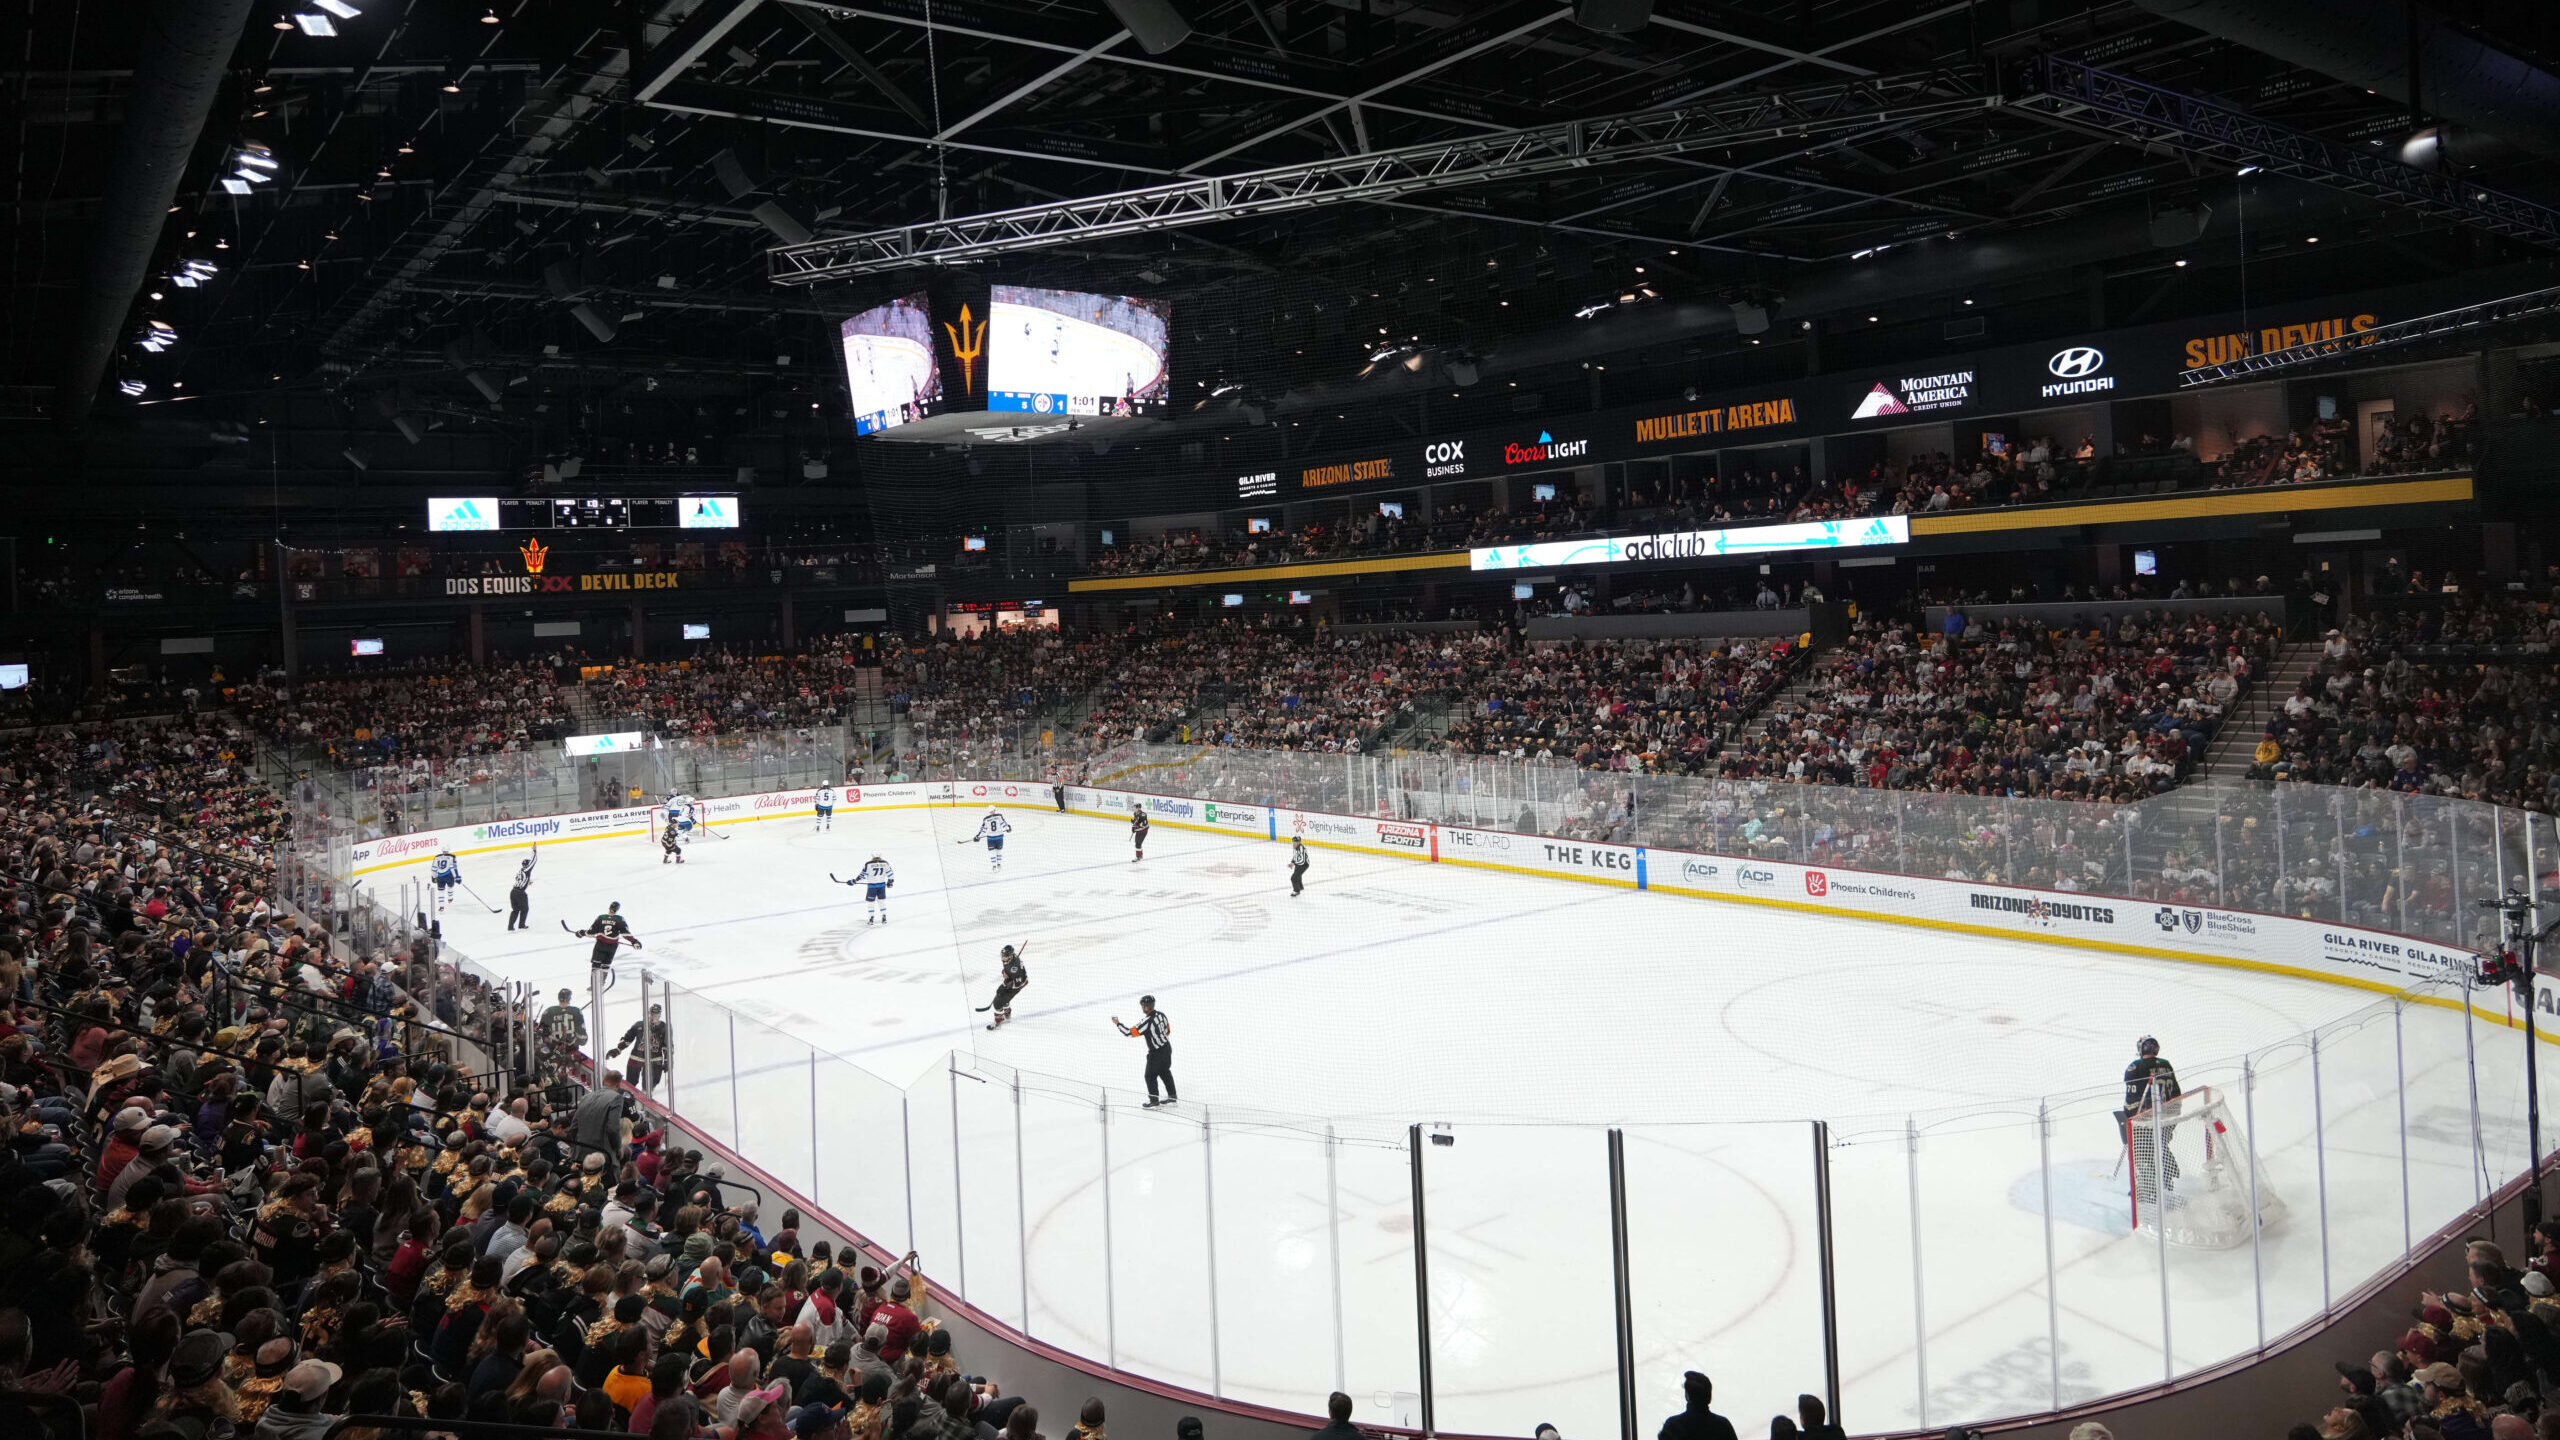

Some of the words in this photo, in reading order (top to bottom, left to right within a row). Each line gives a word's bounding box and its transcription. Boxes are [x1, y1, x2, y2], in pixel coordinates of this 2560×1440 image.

[2185, 332, 2249, 368] SUN
[2261, 314, 2376, 353] DEVILS
[1900, 371, 1973, 392] MOUNTAIN
[2042, 377, 2114, 397] HYUNDAI
[1073, 396, 1095, 406] 1:01
[1907, 386, 1968, 405] AMERICA
[1057, 401, 1064, 410] 1
[1103, 402, 1110, 412] 2
[1913, 403, 1938, 411] CREDIT
[1940, 400, 1962, 408] UNION
[1636, 408, 1723, 443] MULLETT
[1727, 399, 1795, 430] ARENA
[1425, 440, 1464, 464] COX
[1505, 442, 1546, 465] Coors
[1547, 440, 1588, 460] LIGHT
[1302, 463, 1350, 488] ARIZONA
[1353, 458, 1390, 482] STATE
[1427, 463, 1464, 477] BUSINESS
[1239, 475, 1254, 485] GILA
[1255, 472, 1276, 483] RIVER
[563, 507, 570, 515] 2
[439, 520, 490, 530] adidas
[688, 519, 731, 528] adidas
[1625, 531, 1705, 561] adiclub
[1860, 534, 1896, 546] adidas
[890, 572, 937, 580] Mortenson
[446, 577, 479, 595] DOS
[483, 576, 532, 595] EQUIS
[541, 576, 573, 592] XX
[581, 573, 630, 591] DEVIL
[633, 572, 678, 589] DECK
[118, 593, 144, 601] complete
[823, 792, 829, 801] 5
[888, 789, 916, 797] Children's
[713, 803, 741, 813] Health
[754, 793, 790, 810] Bally
[1153, 798, 1194, 818] MedSupply
[588, 814, 609, 822] RIVER
[1207, 808, 1255, 823] enterprise
[488, 819, 560, 839] MedSupply
[991, 820, 997, 831] 8
[1309, 820, 1333, 835] Dignity
[1334, 823, 1357, 834] Health
[1379, 825, 1422, 837] ARIZONA
[1383, 834, 1423, 847] SPORTS
[377, 839, 411, 857] Bally
[411, 838, 438, 850] SPORTS
[1544, 845, 1583, 865] THE
[1592, 850, 1631, 870] KEG
[437, 860, 447, 869] 19
[1688, 863, 1718, 876] ACP
[873, 868, 884, 876] 71
[1742, 869, 1774, 882] ACP
[1830, 881, 1867, 895] Phoenix
[1869, 886, 1916, 900] Children's
[1971, 893, 2034, 914] ARIZONA
[2041, 902, 2113, 923] COYOTES
[2207, 912, 2252, 924] BlueCross
[604, 925, 613, 935] 2
[2207, 921, 2255, 934] BlueShield
[2324, 933, 2356, 948] GILA
[2359, 938, 2400, 956] RIVER
[2324, 946, 2359, 956] RESORTS
[2369, 954, 2400, 964] CASINOS
[2407, 948, 2438, 964] GILA
[2127, 1085, 2137, 1093] 70
